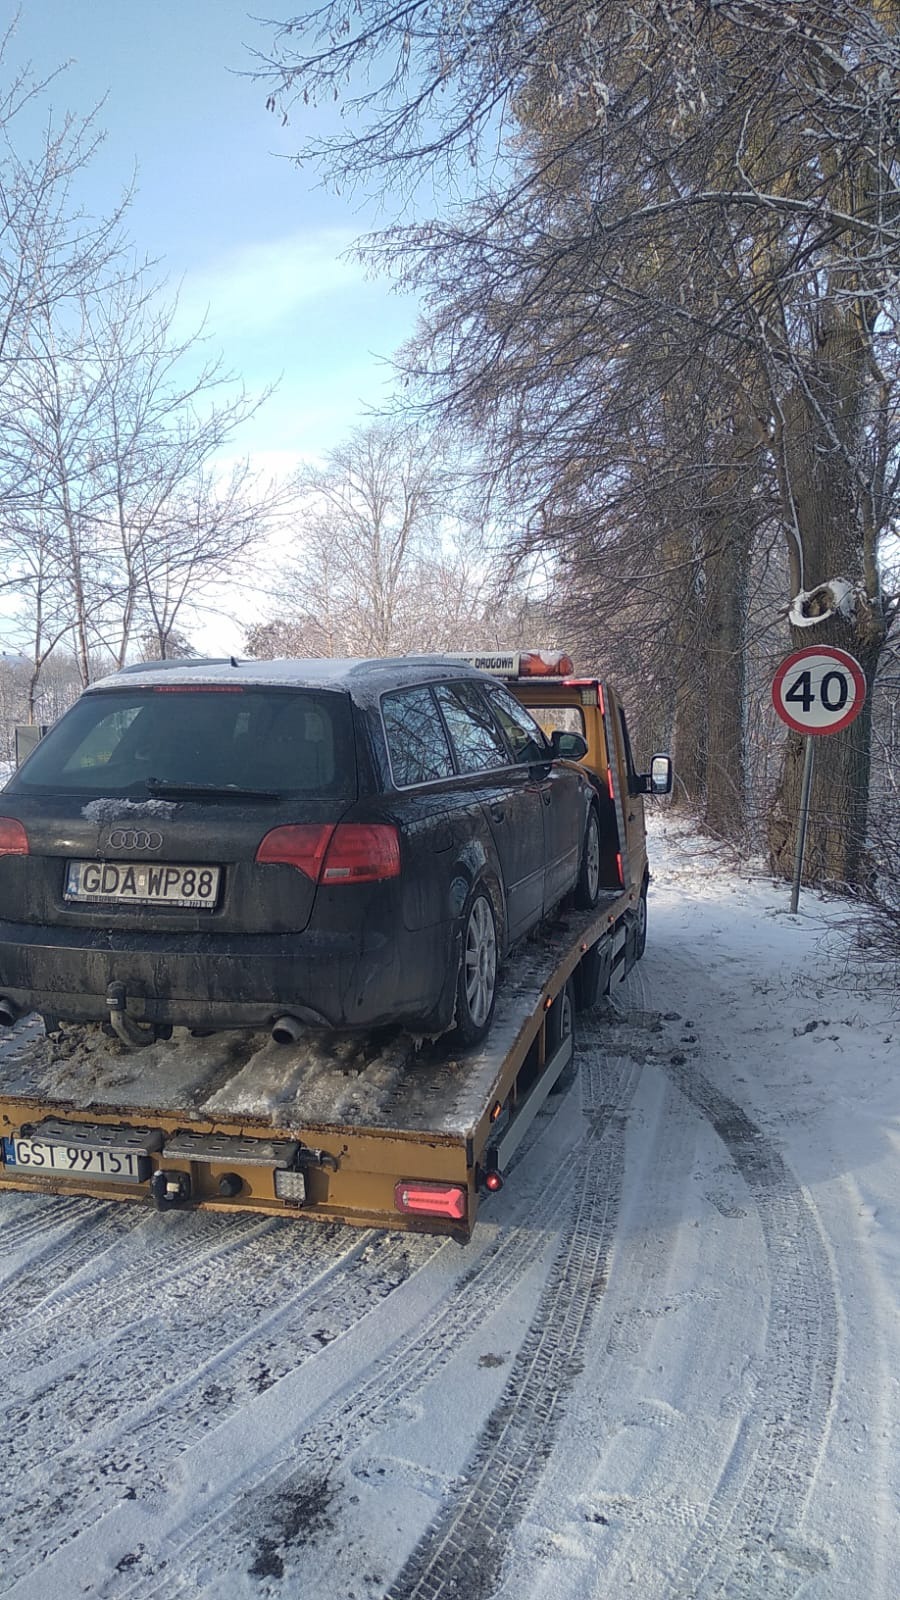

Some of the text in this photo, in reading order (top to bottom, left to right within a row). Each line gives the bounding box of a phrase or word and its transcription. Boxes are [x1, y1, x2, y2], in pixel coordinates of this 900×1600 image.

[785, 671, 848, 712] 40
[83, 864, 213, 898] GDA WP88
[16, 1141, 134, 1175] GST 99151
